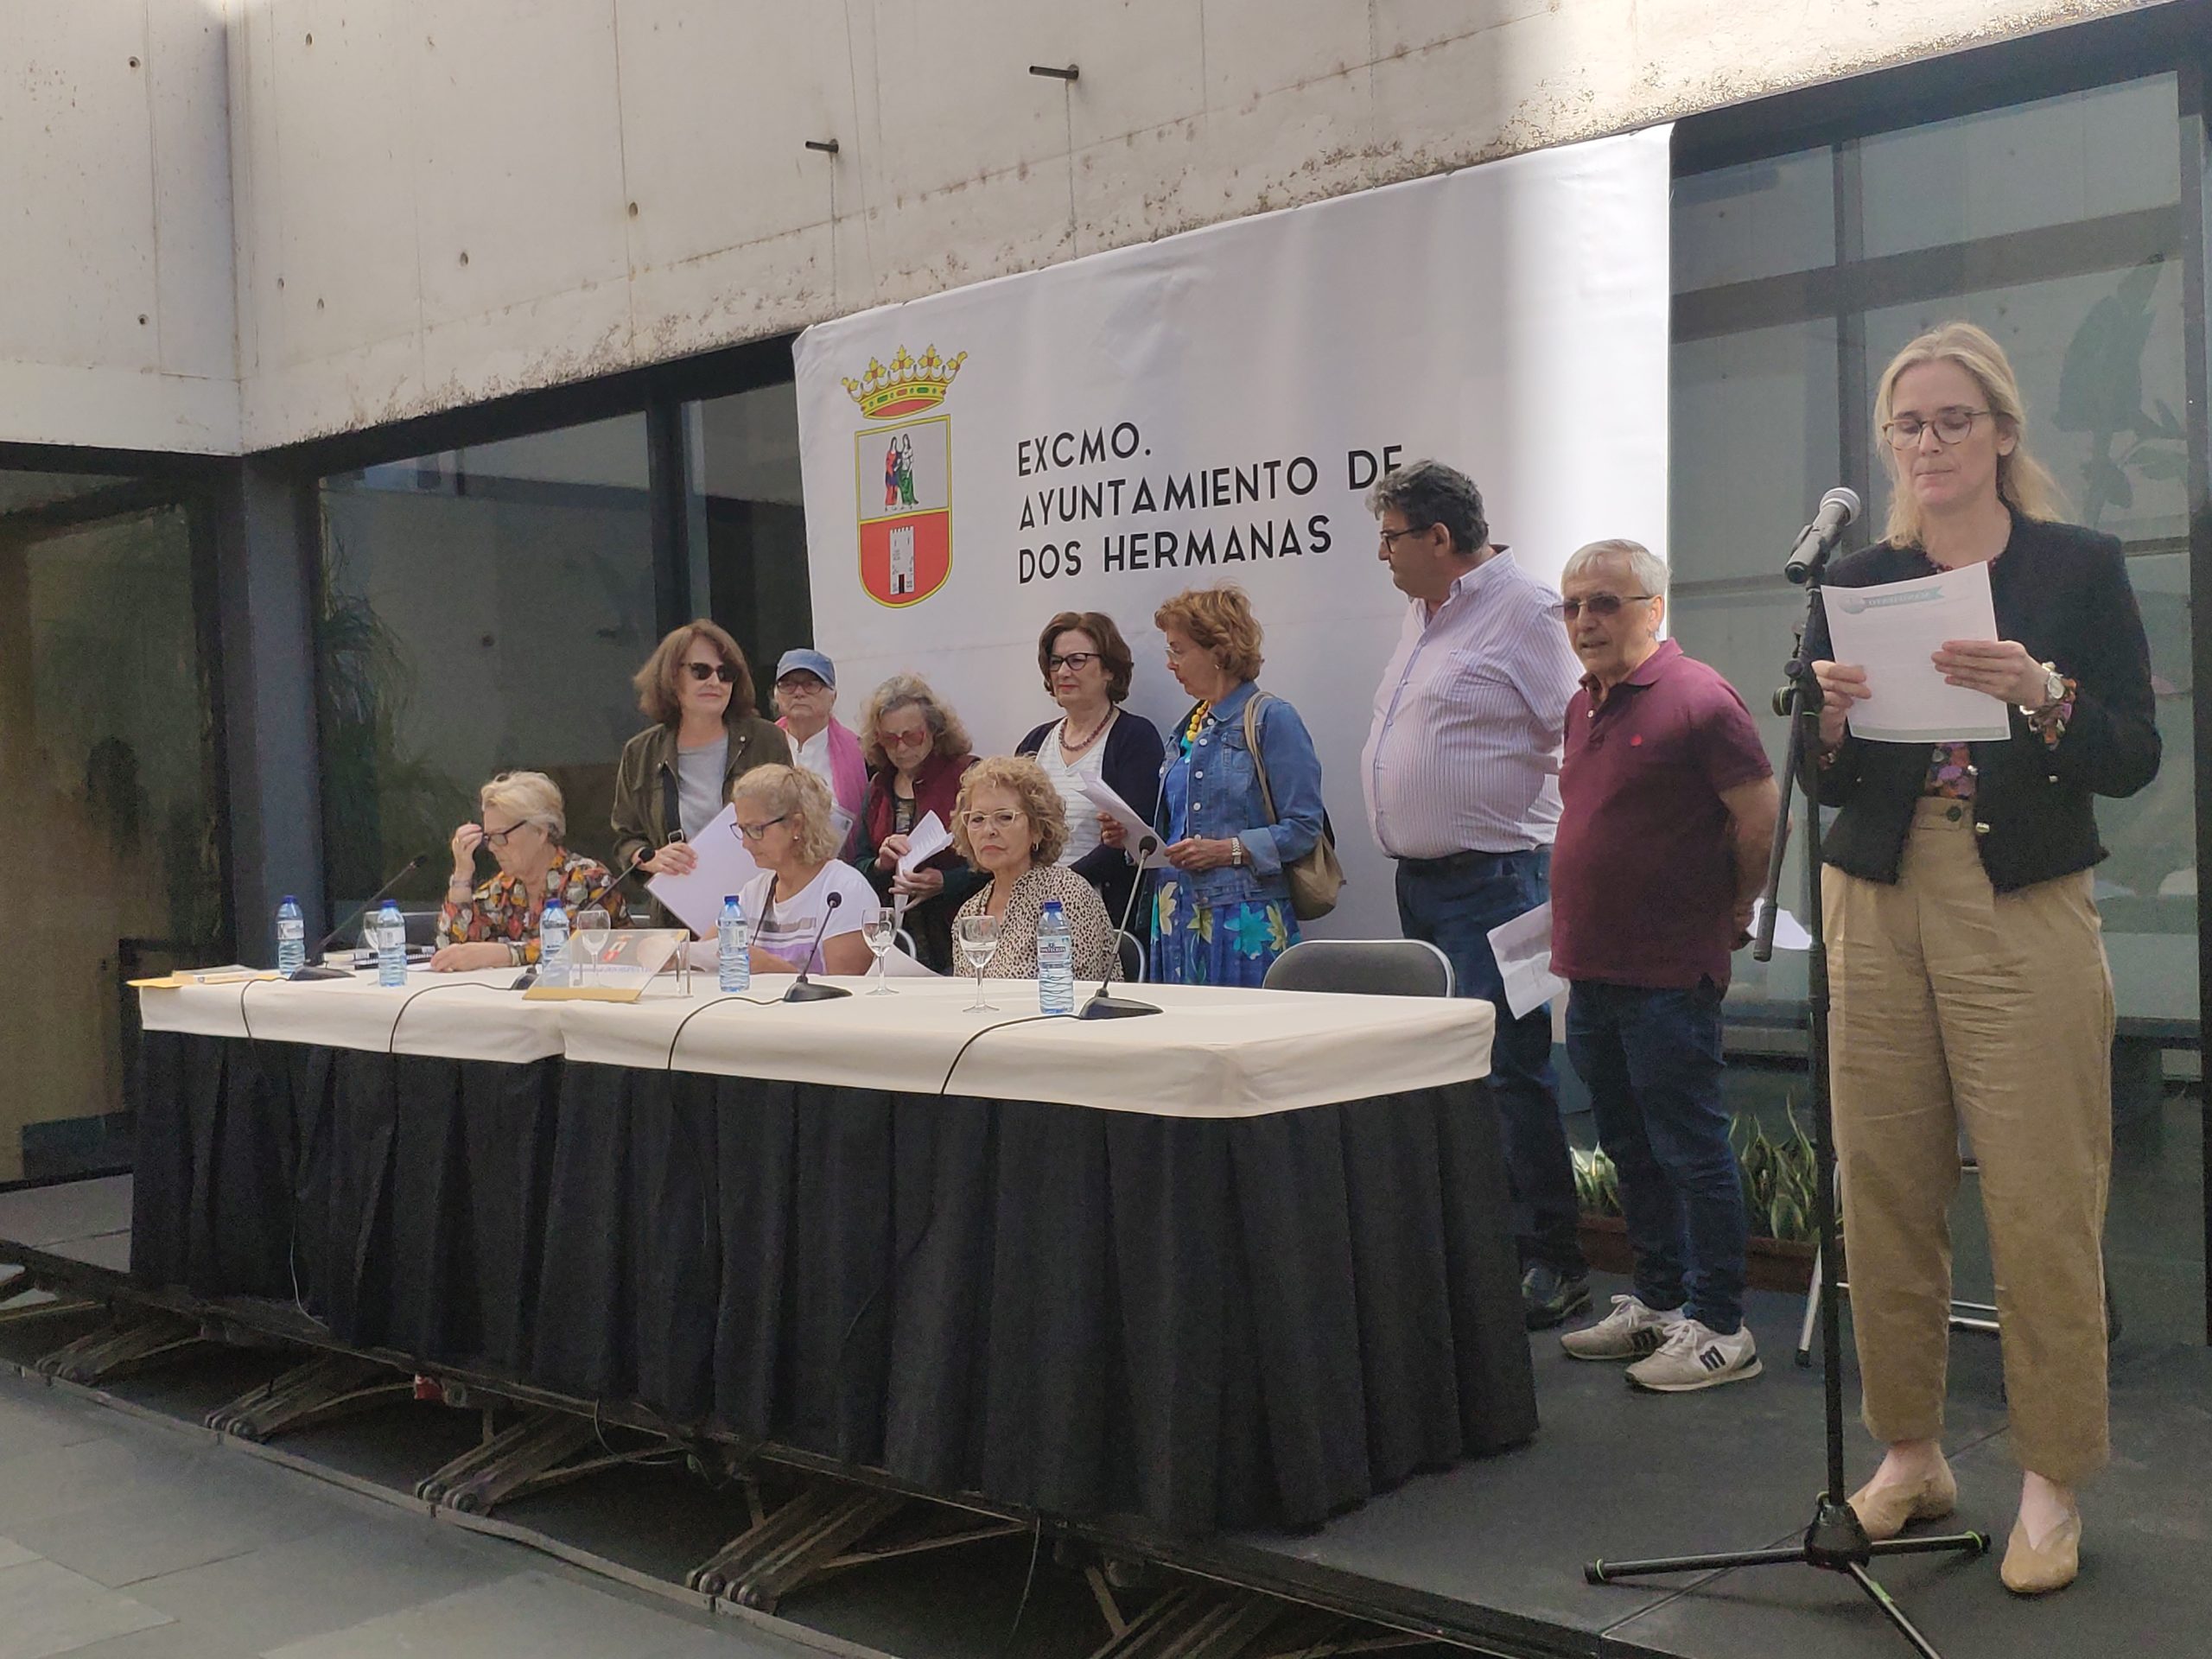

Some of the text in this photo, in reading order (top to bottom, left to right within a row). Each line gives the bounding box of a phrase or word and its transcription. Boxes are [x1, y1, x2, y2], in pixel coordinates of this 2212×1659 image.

[1018, 422, 1152, 477] EXCMO.
[1019, 444, 1403, 531] AYUNTAMIENTO DE
[1019, 515, 1332, 584] DOS HERMANAS
